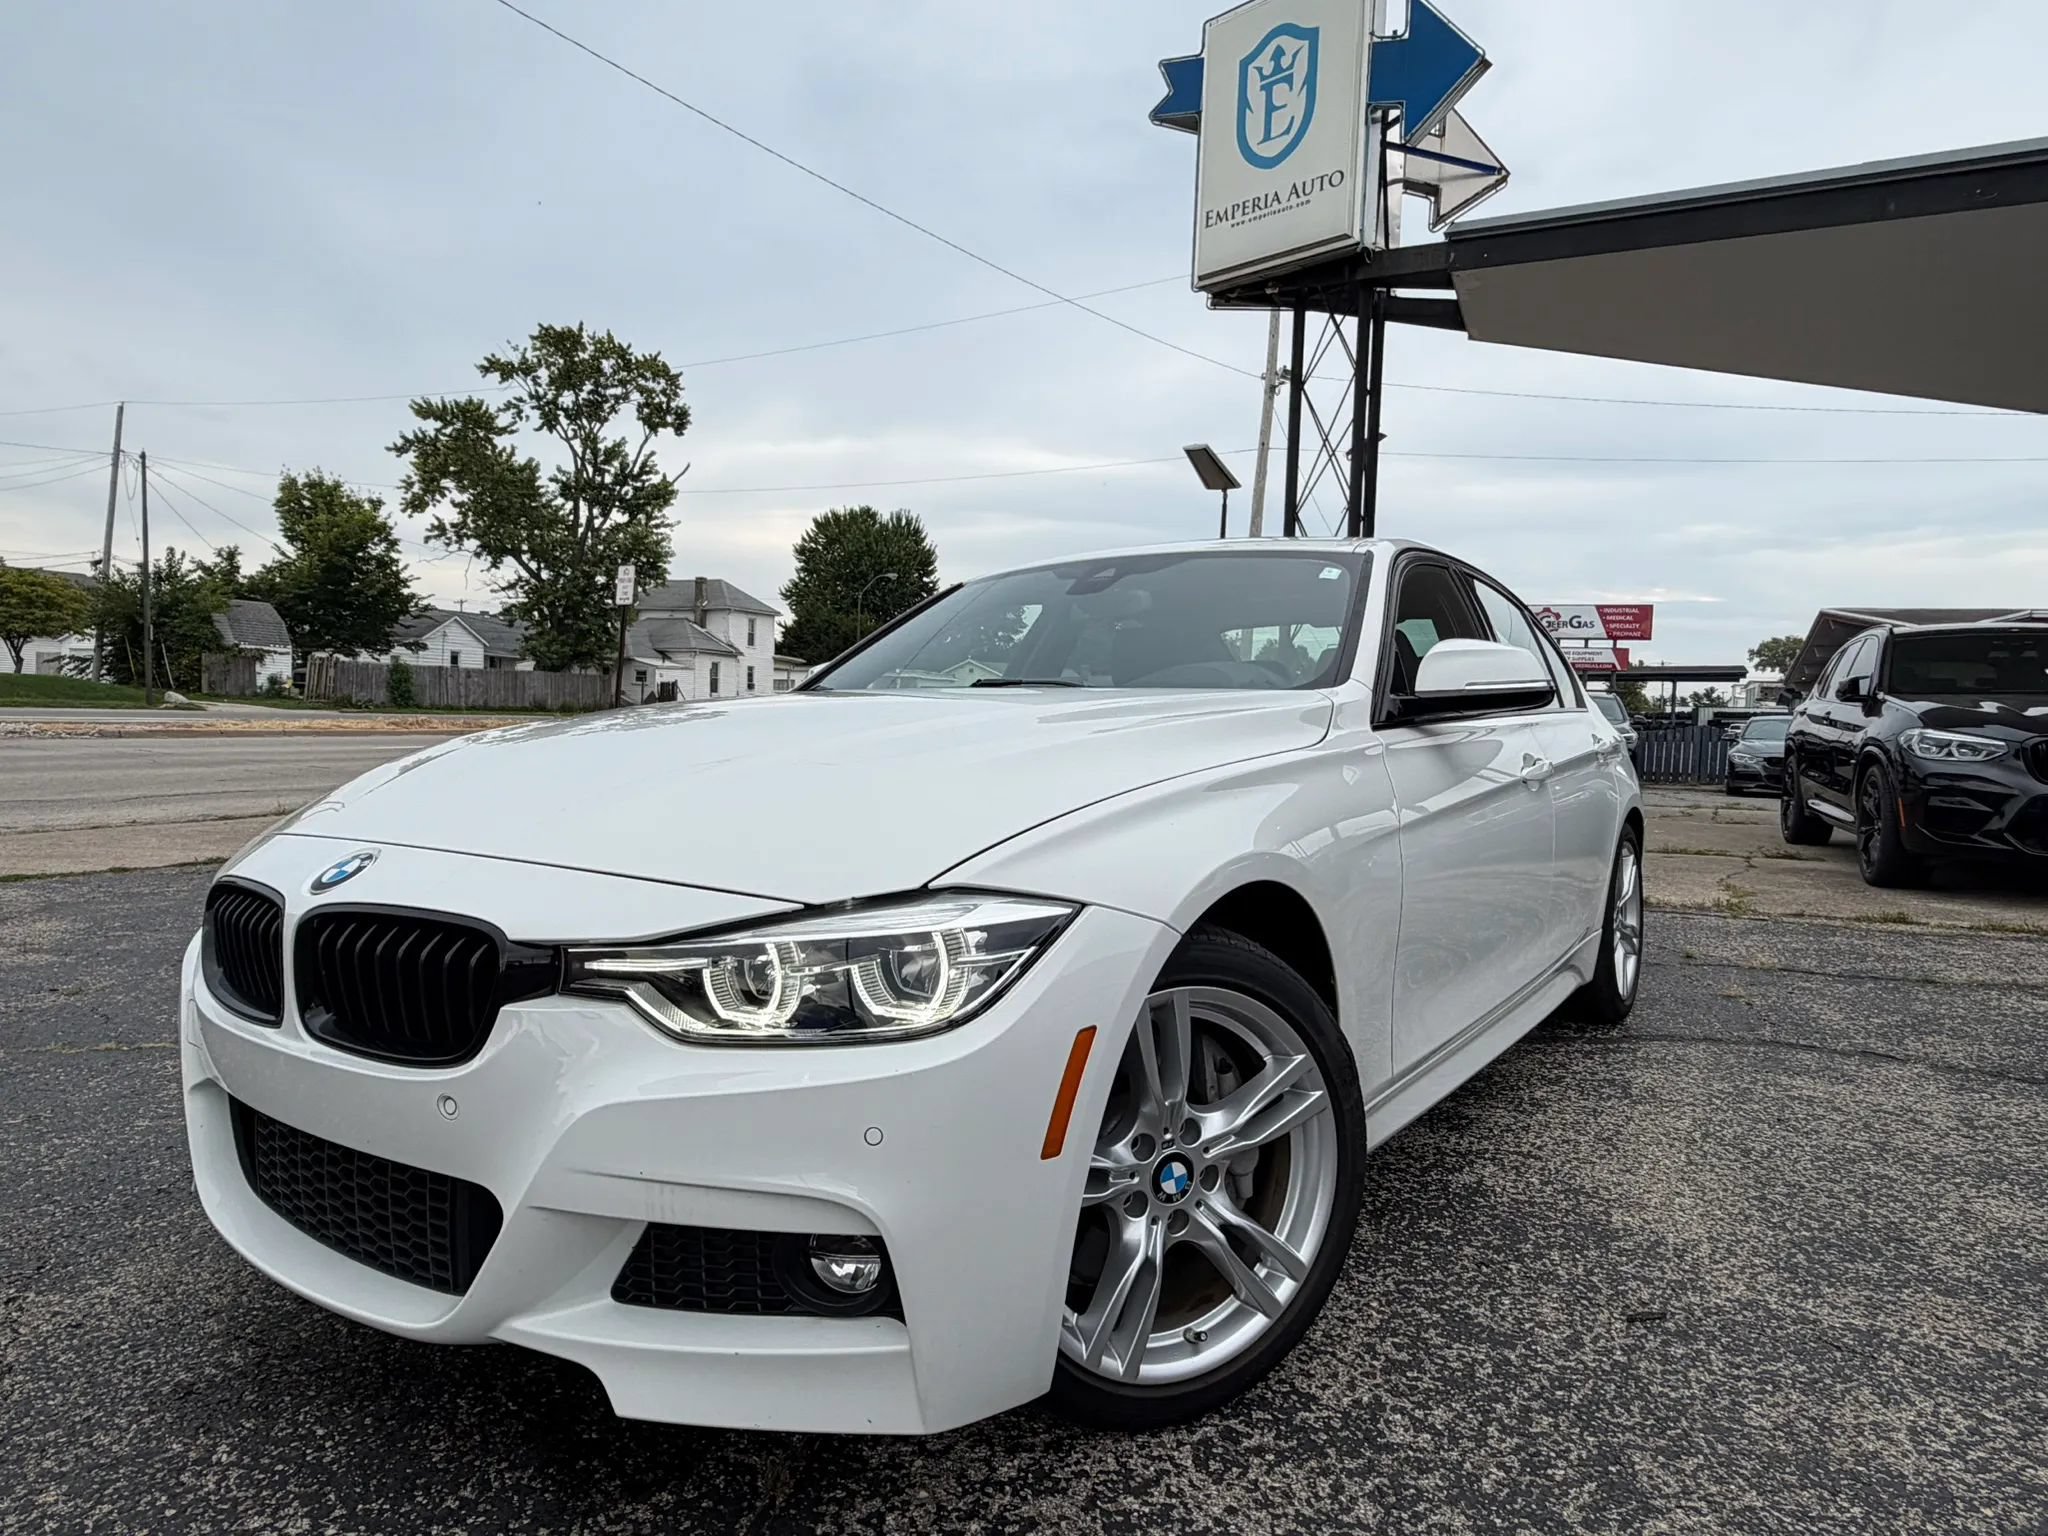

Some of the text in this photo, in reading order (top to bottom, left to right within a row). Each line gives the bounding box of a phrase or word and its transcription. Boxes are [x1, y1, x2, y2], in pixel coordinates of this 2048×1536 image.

[1204, 169, 1345, 229] EMPERIA AUTO
[1230, 199, 1312, 228] www.emperiaauto.com
